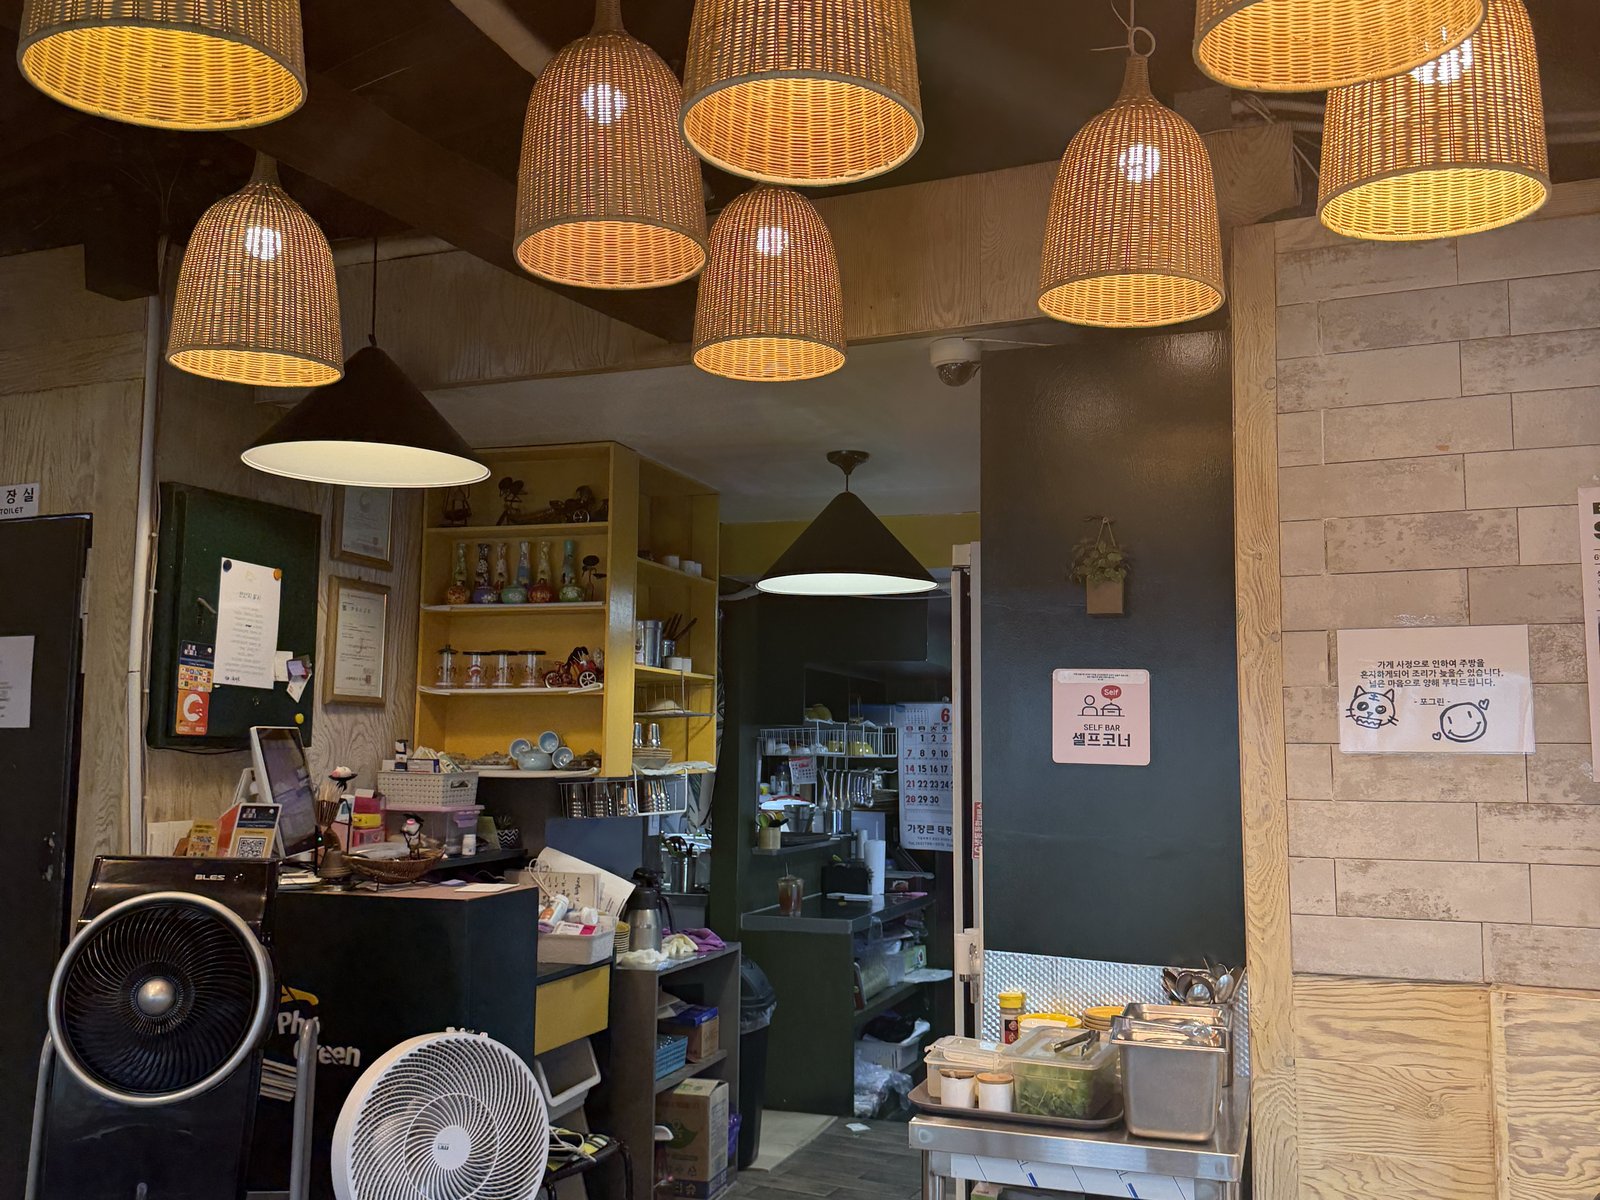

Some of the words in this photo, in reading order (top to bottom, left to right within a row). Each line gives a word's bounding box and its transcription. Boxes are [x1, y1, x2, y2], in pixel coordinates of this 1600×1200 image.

[1377, 660, 1394, 669] 가게
[1396, 660, 1430, 669] 사정으로
[1432, 659, 1457, 668] 인하여
[1459, 658, 1485, 668] 주방을
[1360, 670, 1410, 679] 혼자하게되어
[1412, 669, 1437, 678] 조리가
[1467, 668, 1504, 677] 있습니다.
[1388, 679, 1421, 688] 마음으로
[1423, 679, 1440, 687] 양해
[1442, 677, 1496, 687] 부탁드립니다.
[1104, 688, 1118, 696] Self
[1420, 697, 1445, 706] 포그린
[941, 708, 950, 722] 6
[1083, 723, 1103, 731] SELF
[1105, 724, 1120, 732] BAR
[920, 734, 925, 742] 1
[931, 734, 936, 742] 2
[1072, 732, 1131, 747] 셀프코너
[907, 749, 912, 757] 7
[931, 749, 937, 757] 9
[905, 764, 915, 772] 14
[918, 764, 927, 772] 15
[930, 764, 938, 773] 16
[940, 765, 948, 773] 17
[940, 781, 949, 789] 24
[917, 795, 928, 803] 29
